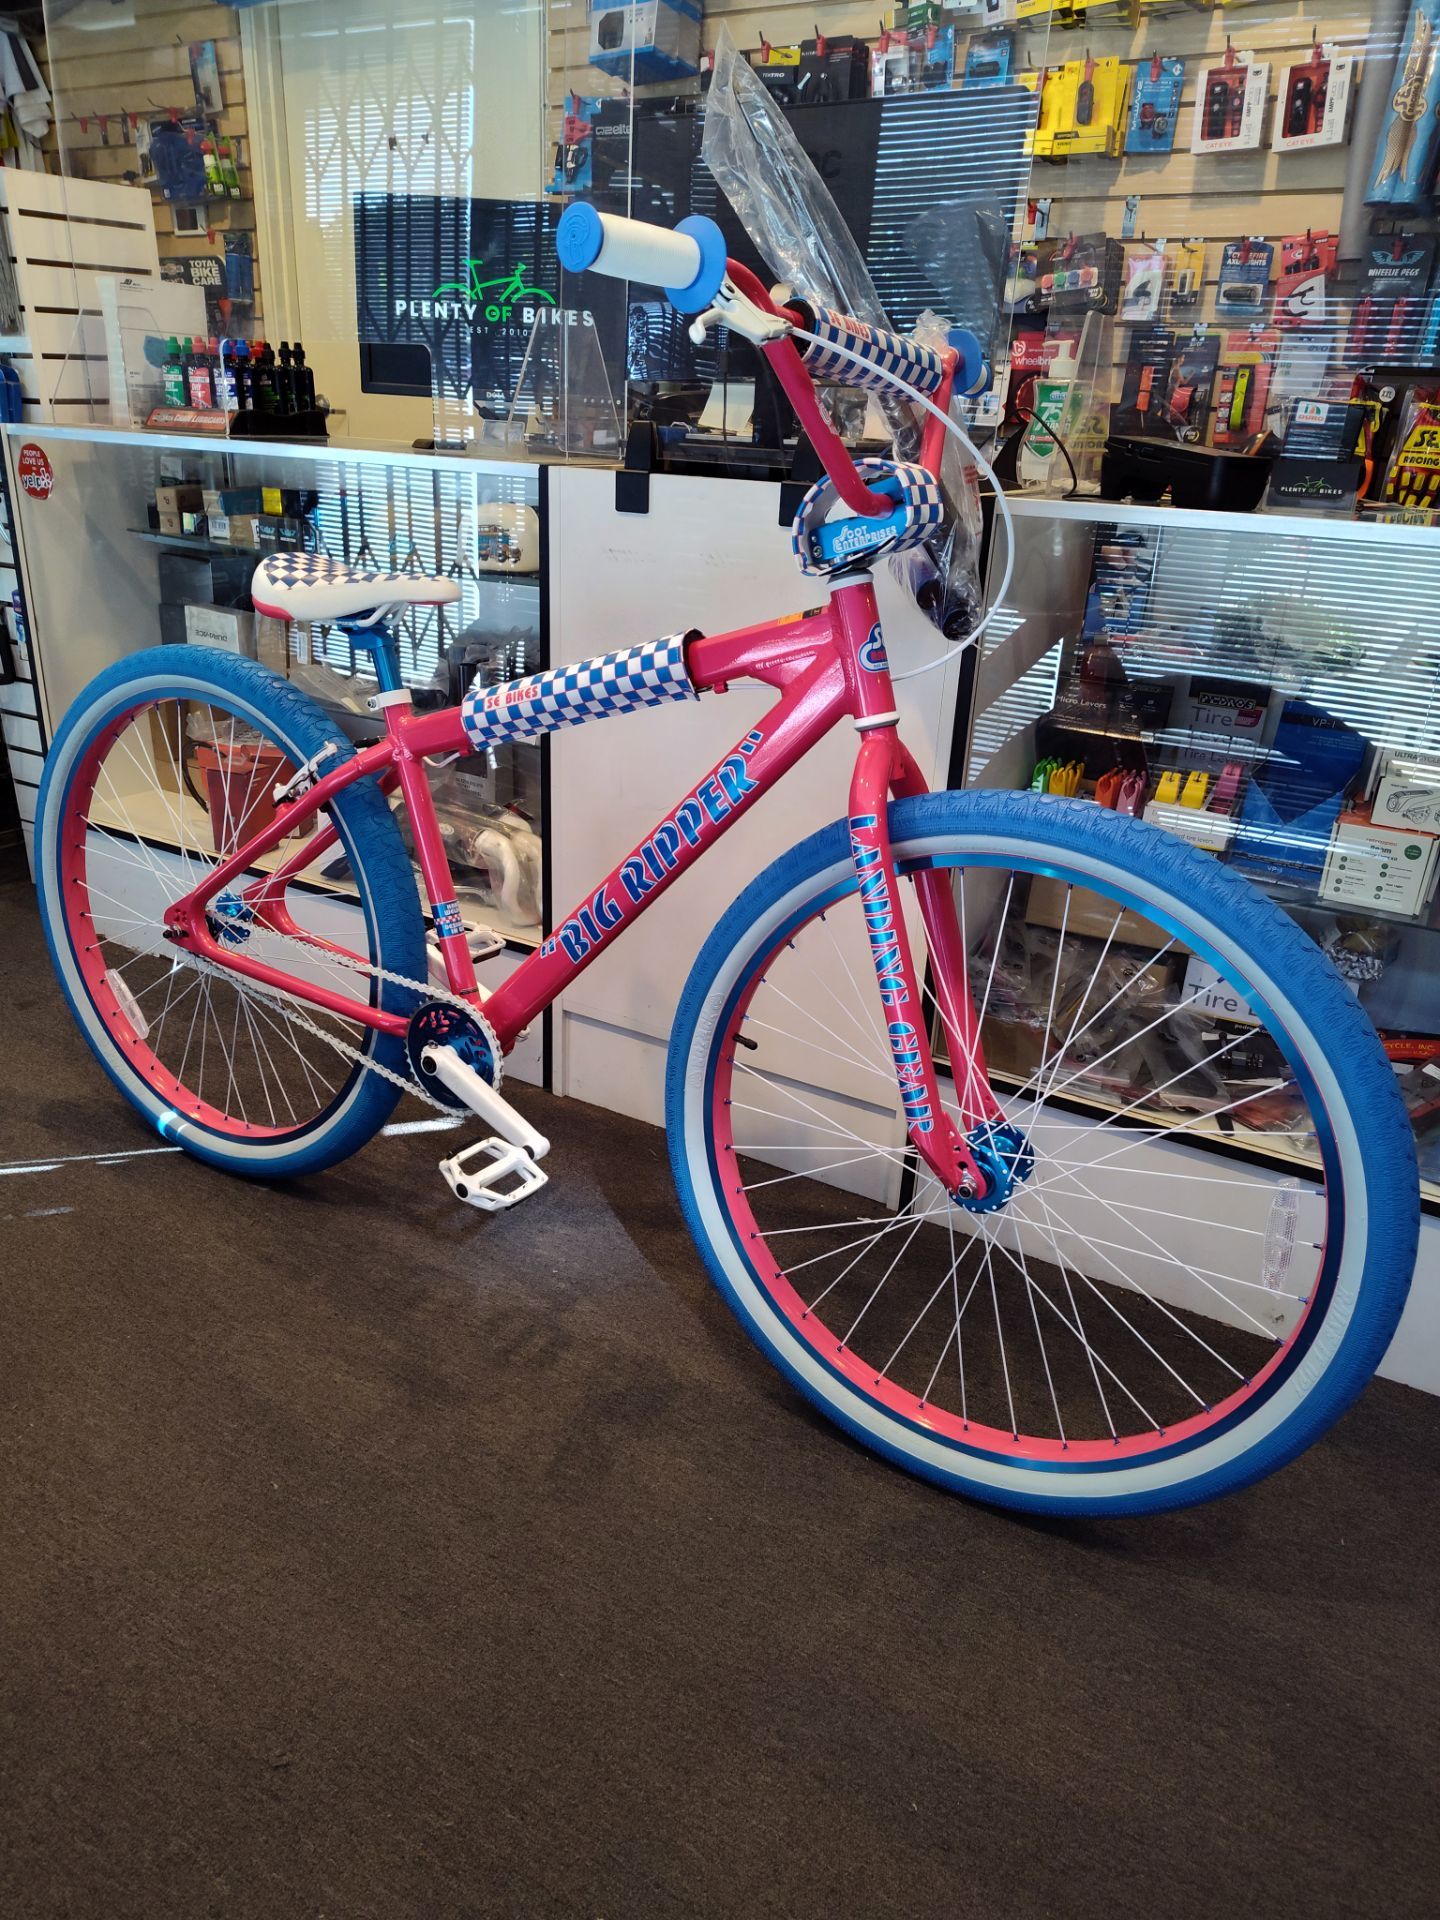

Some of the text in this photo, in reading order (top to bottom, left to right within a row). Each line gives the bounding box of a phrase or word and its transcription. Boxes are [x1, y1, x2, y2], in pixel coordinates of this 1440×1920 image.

[1131, 80, 1143, 131] M-WAVE
[1231, 252, 1268, 260] CYEFIRE
[190, 267, 220, 277] BIKE
[1368, 268, 1420, 277] WHEELIE PEGS
[192, 277, 222, 286] CARE
[394, 300, 594, 327] PLENTY OF BIKES
[470, 326, 529, 337] EST 2010
[1015, 356, 1052, 366] wheelbri
[1413, 430, 1440, 448] SE
[23, 449, 41, 457] PEOPLE
[22, 457, 44, 466] LOVE US
[1403, 457, 1440, 467] RACING
[22, 472, 43, 490] yelp
[833, 525, 897, 552] ENTERPRISES
[487, 686, 538, 709] SE BIKES
[1056, 695, 1107, 709] Micro Levers
[1191, 705, 1233, 726] Tire
[1183, 748, 1206, 759] Tire
[850, 814, 935, 1134] LANDING GEAR
[1188, 983, 1238, 1012] Tire
